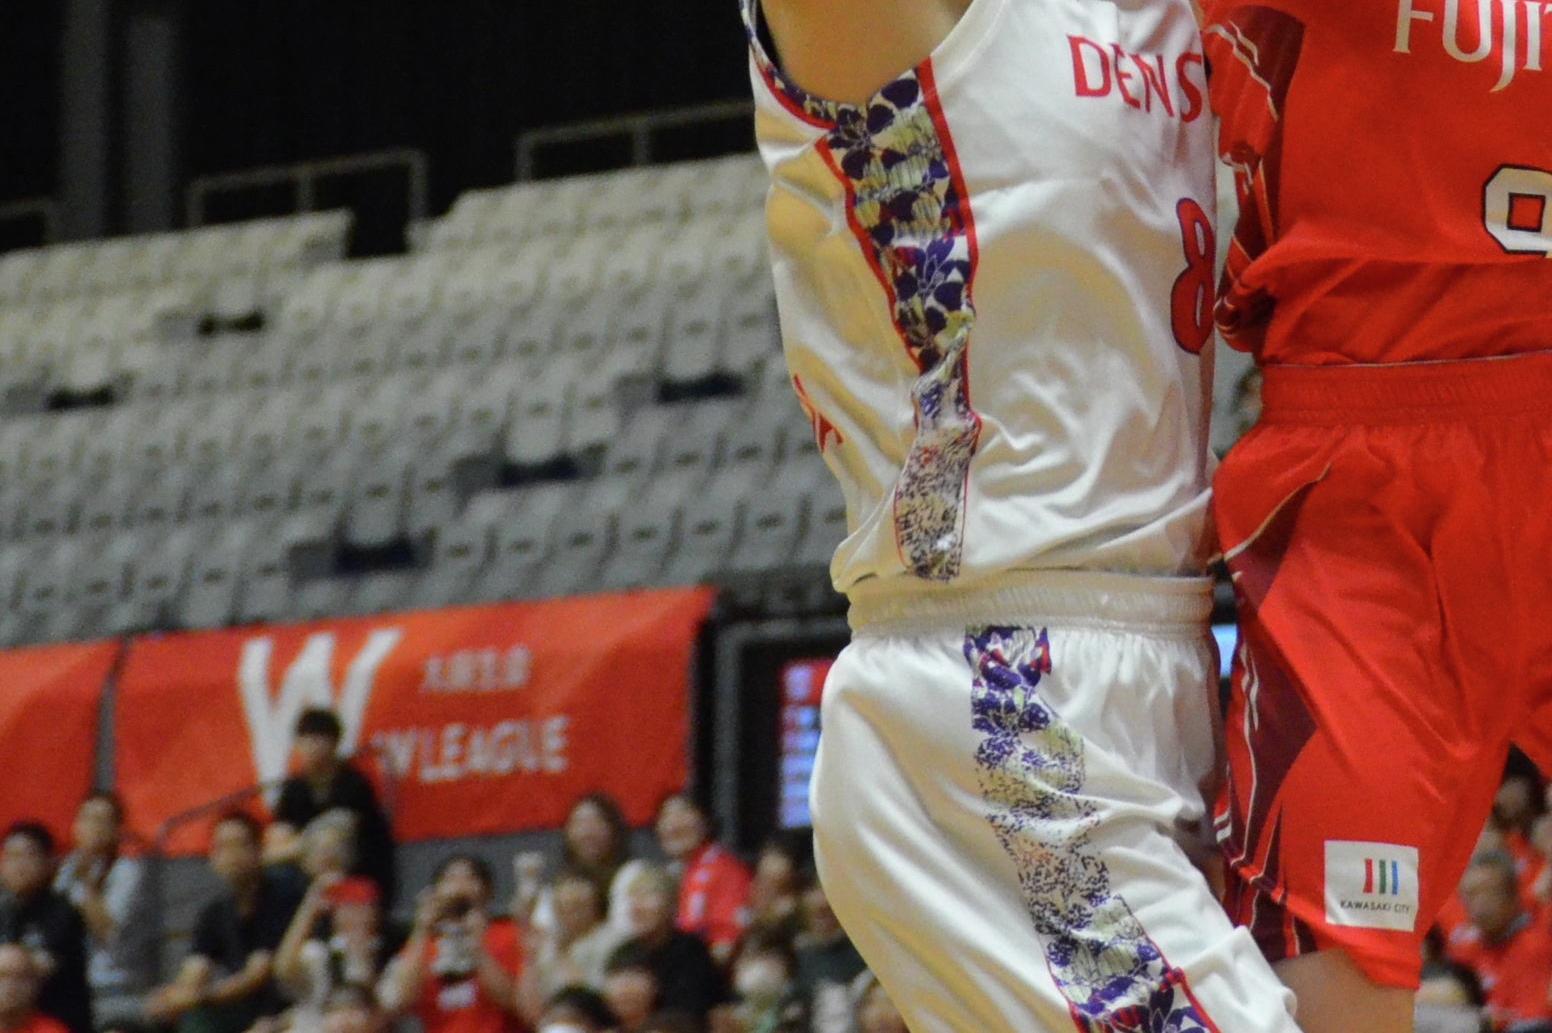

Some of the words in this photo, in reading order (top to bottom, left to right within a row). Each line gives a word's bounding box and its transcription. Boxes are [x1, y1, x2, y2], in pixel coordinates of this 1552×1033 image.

[1171, 197, 1215, 355] 8
[1340, 899, 1391, 912] KAWASAKI
[1394, 903, 1411, 913] CITY
